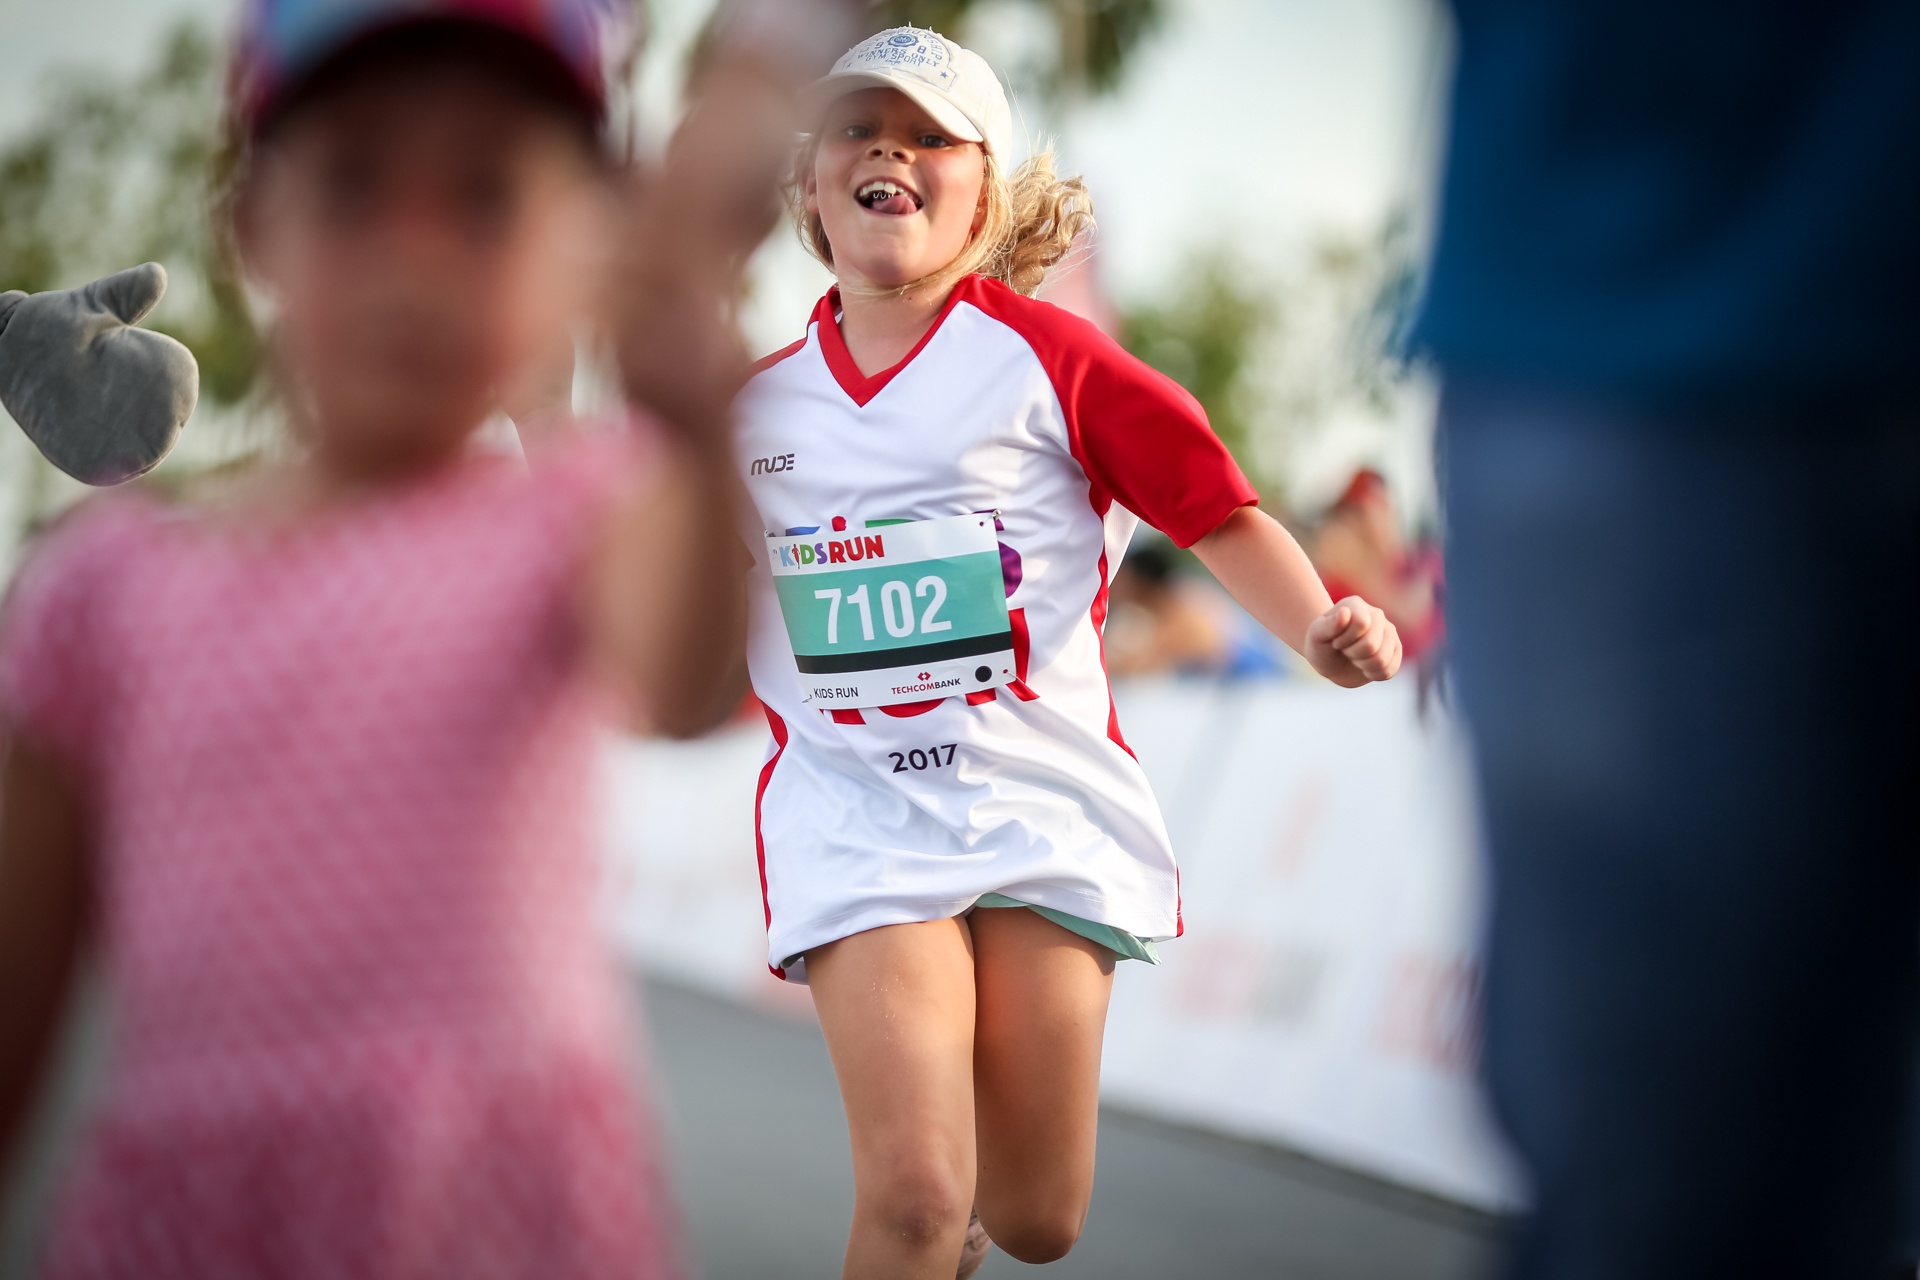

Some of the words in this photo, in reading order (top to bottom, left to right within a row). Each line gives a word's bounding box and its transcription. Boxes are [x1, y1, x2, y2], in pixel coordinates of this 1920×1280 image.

[858, 47, 907, 60] WINNERS
[911, 53, 940, 68] ONLY
[751, 453, 795, 475] MUDE
[814, 575, 952, 644] 7102
[813, 687, 834, 699] KIDS
[836, 687, 859, 699] RUN
[891, 677, 961, 695] TECHCOMBANK
[888, 743, 958, 773] 2017
